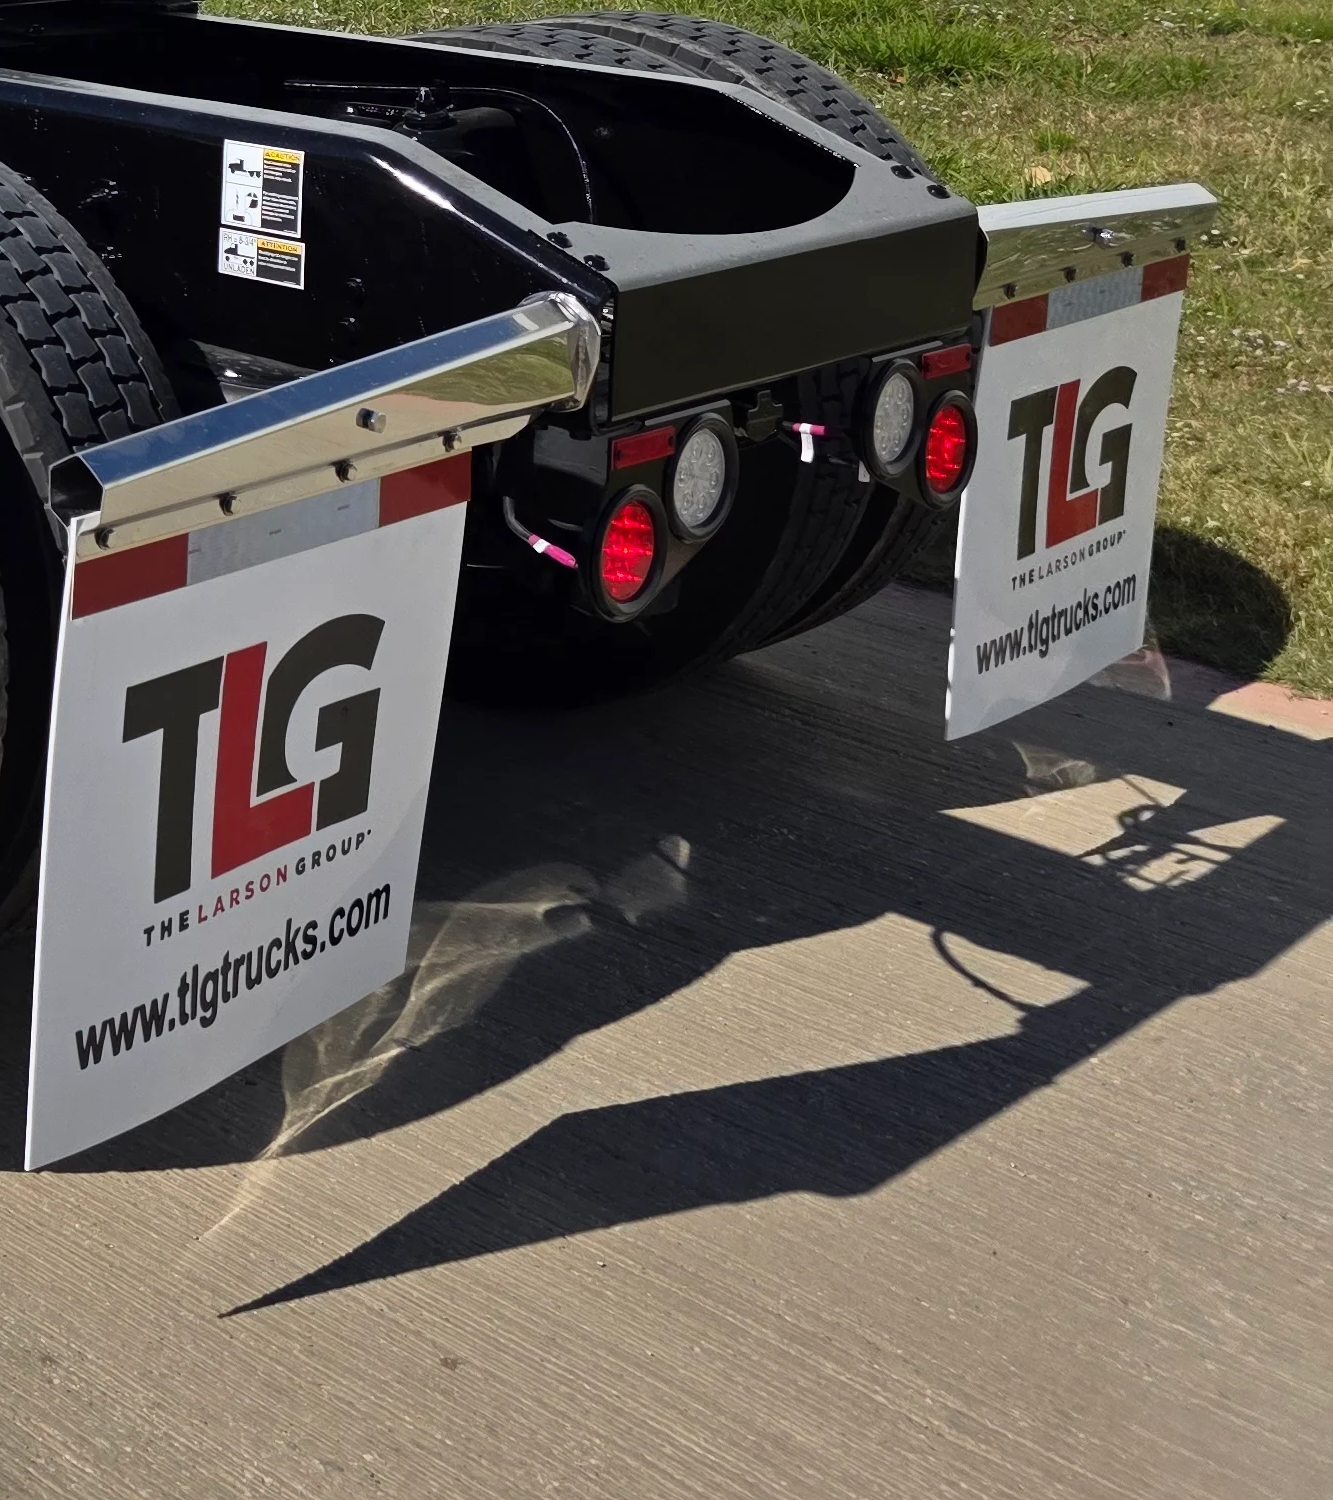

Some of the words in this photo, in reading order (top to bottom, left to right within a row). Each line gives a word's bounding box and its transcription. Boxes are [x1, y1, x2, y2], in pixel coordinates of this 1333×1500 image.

[261, 241, 299, 253] ATTENTION
[1007, 365, 1138, 560] TLG
[1010, 568, 1035, 591] THE
[1037, 547, 1086, 585] LARSON
[1087, 532, 1124, 560] GROUP
[976, 572, 1137, 675] www.tlgtrucks.com
[121, 613, 386, 904] TLG
[143, 910, 191, 948] THE
[196, 866, 290, 924] LARSON
[295, 835, 366, 876] GROUP
[75, 882, 392, 1070] www.tlgtrucks.com
